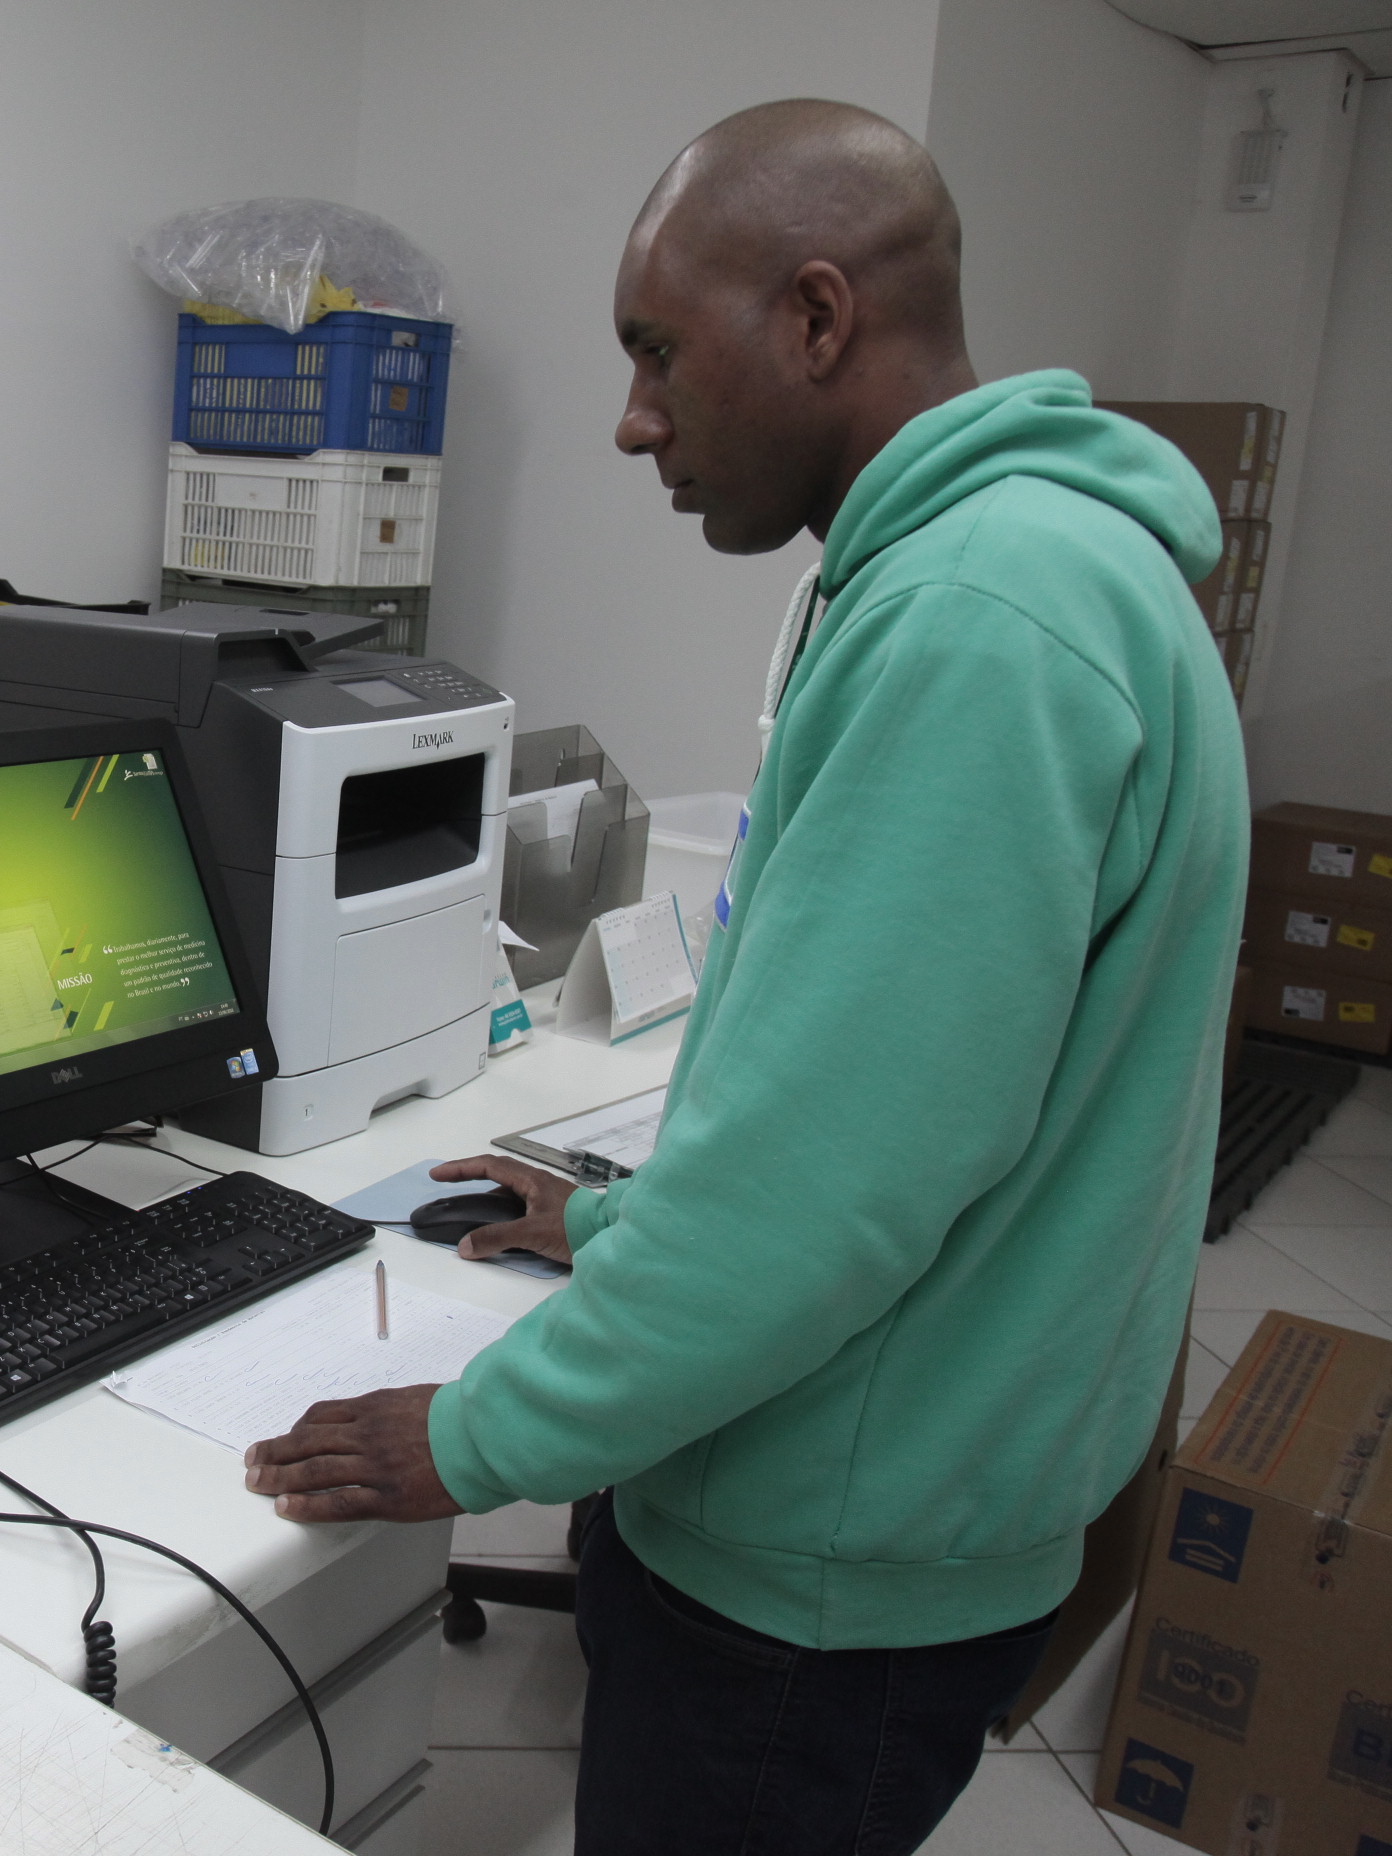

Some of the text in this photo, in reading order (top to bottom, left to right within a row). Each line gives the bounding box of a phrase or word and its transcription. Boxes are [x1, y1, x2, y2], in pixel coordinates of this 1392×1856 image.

[412, 731, 454, 750] LEXMARK
[178, 932, 190, 940] para
[117, 955, 135, 965] prestar
[140, 950, 158, 960] melhor
[184, 940, 206, 950] medicina
[181, 953, 198, 962] dentro
[57, 972, 93, 990] MISSÃO
[133, 976, 152, 986] padrão
[159, 968, 183, 979] qualidade
[183, 961, 212, 973] reconhecido
[134, 985, 149, 997] Brasil
[51, 1066, 83, 1085] DELL
[1154, 1616, 1261, 1667] Certificado
